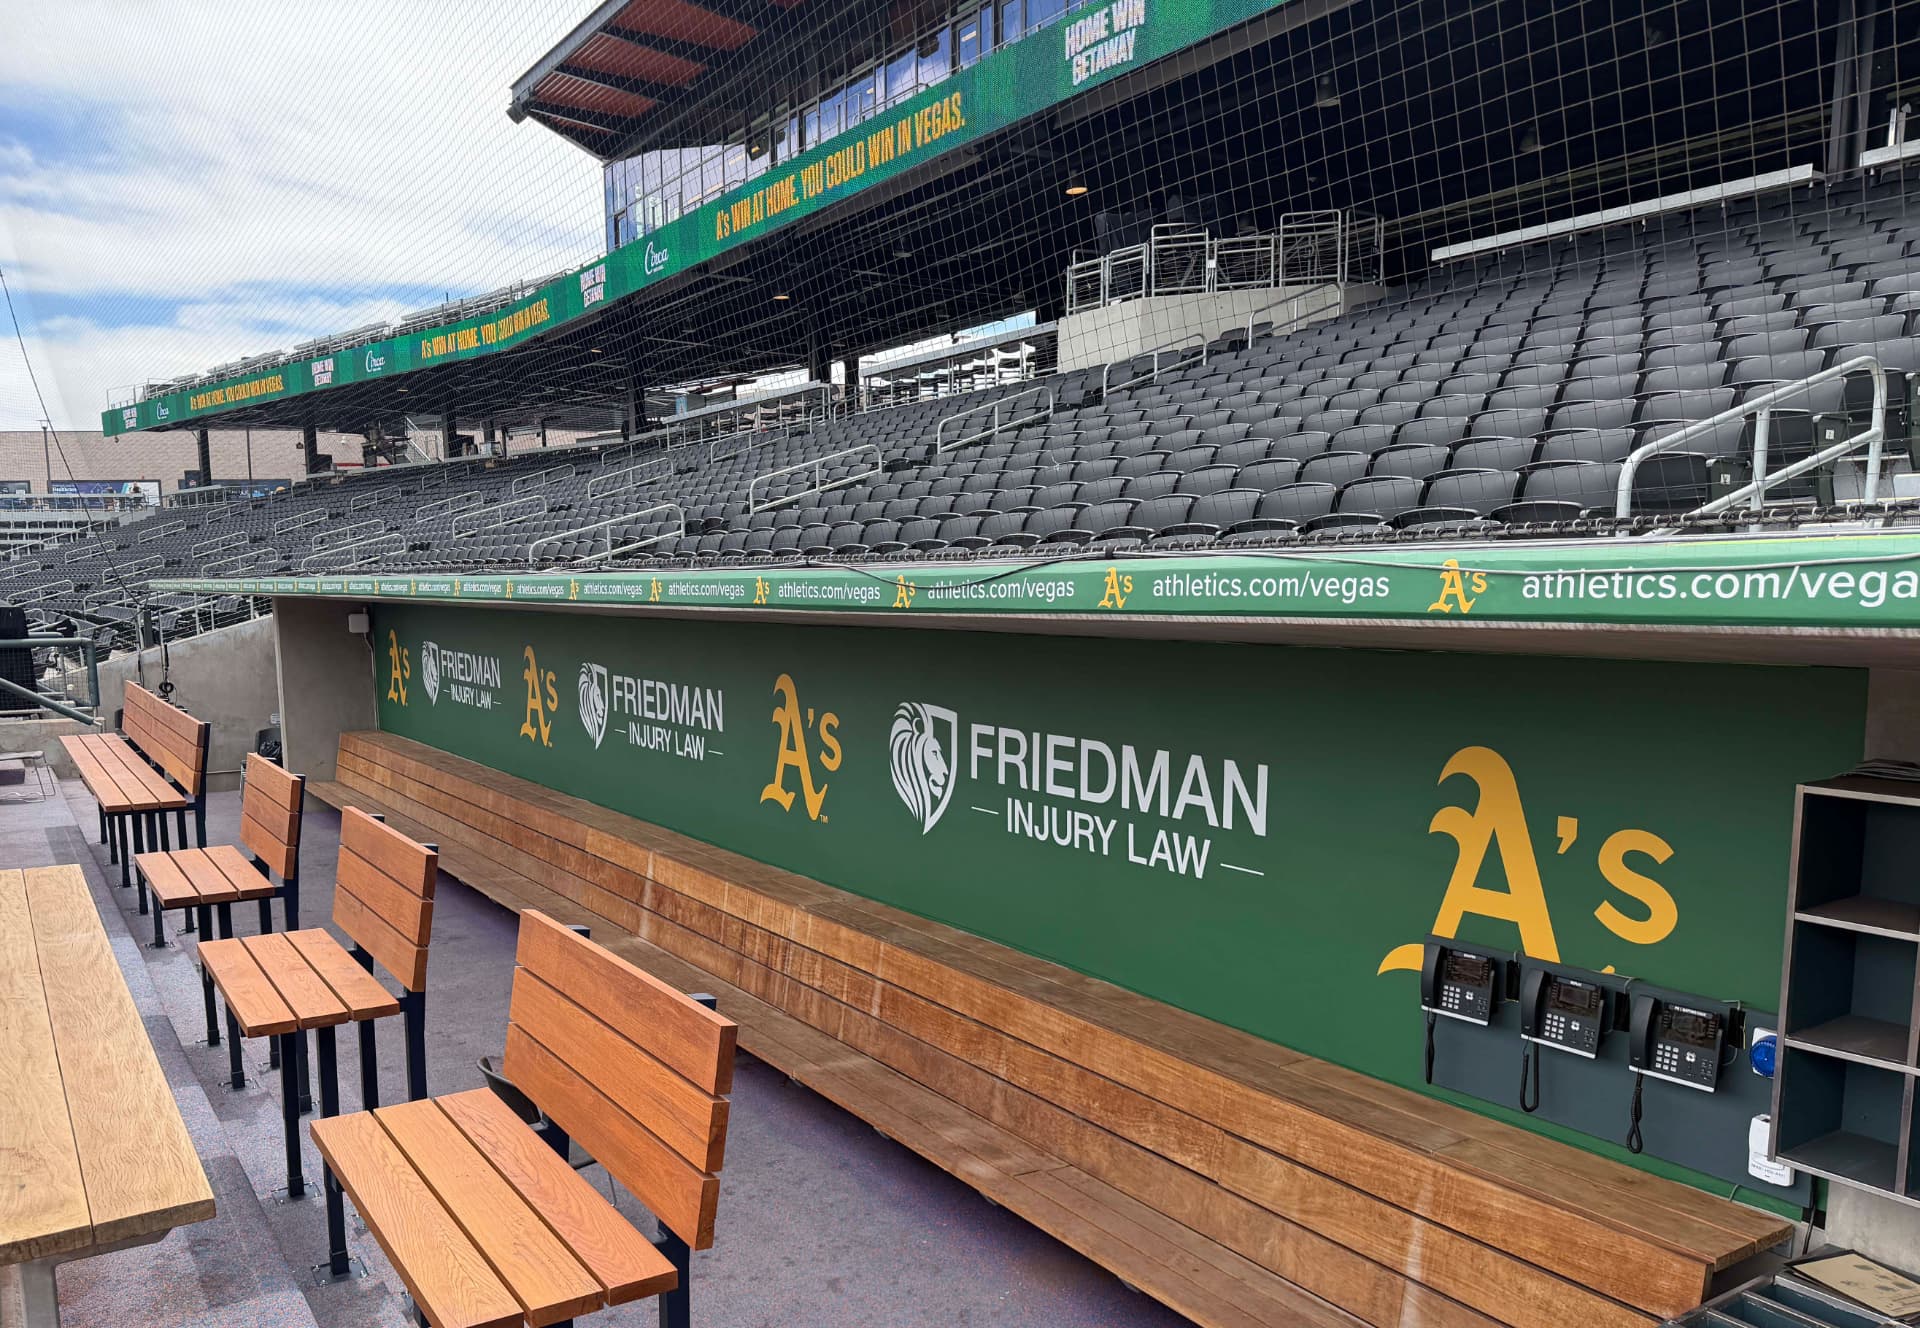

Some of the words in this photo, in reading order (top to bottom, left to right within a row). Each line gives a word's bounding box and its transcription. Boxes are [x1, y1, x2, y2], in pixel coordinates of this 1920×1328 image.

[1065, 7, 1108, 61] HOME
[1111, 0, 1145, 32] WIN
[1072, 28, 1136, 86] GETAWAY
[716, 210, 730, 240] A's
[731, 197, 751, 233] WIN
[753, 190, 764, 223] AT
[766, 175, 799, 217] HOME.
[801, 160, 824, 200] YOU
[826, 141, 865, 189] COULD
[868, 125, 895, 169] WIN
[898, 117, 911, 156] IN
[915, 92, 965, 148] VEGAS.
[645, 241, 669, 275] Circa
[366, 350, 386, 372] Circa
[422, 339, 432, 359] A's
[432, 336, 447, 356] WIN
[448, 332, 456, 352] AT
[457, 327, 480, 350] HOME.
[481, 323, 496, 344] YOU
[583, 582, 642, 599] athletics.com/vegas
[649, 576, 662, 603] A's
[668, 581, 744, 600] athletics.com/vegas
[753, 576, 769, 605] A's
[778, 581, 880, 604] athletics.com/vegas
[893, 575, 916, 608] A's
[926, 576, 1074, 603] athletics.com/vegas
[1097, 568, 1133, 609] A's
[1152, 572, 1391, 605] athletics.com/vegas
[1427, 558, 1488, 613] A's
[388, 628, 411, 706] A's
[440, 649, 501, 689] FRIEDMAN
[450, 684, 474, 708] INJURY
[476, 690, 492, 710] LAW
[520, 645, 558, 747] A's
[613, 675, 724, 732] FRIEDMAN
[628, 721, 671, 752] INJURY
[675, 731, 705, 761] LAW
[760, 673, 842, 821] A's
[970, 723, 1269, 836] FRIEDMAN
[1006, 797, 1117, 856] INJURY
[1128, 822, 1211, 878] LAW
[1377, 745, 1679, 976] A's
